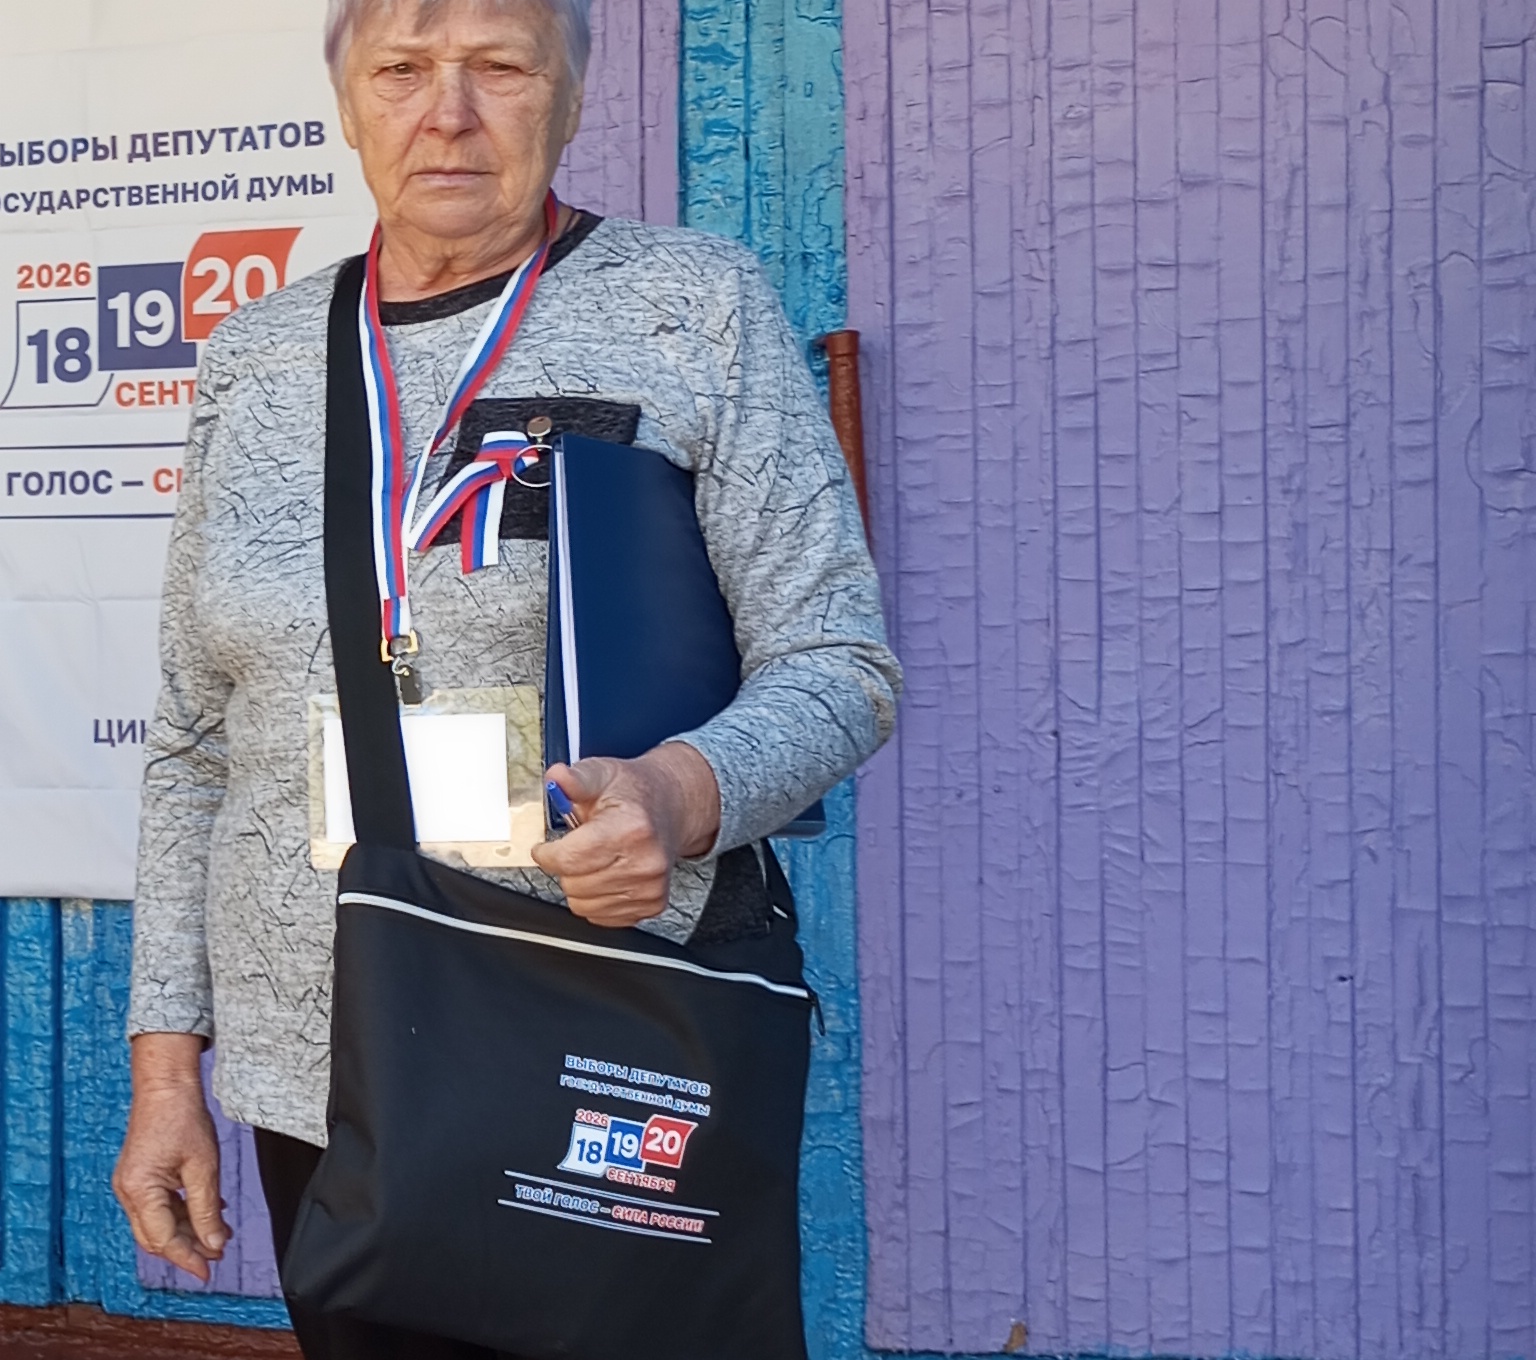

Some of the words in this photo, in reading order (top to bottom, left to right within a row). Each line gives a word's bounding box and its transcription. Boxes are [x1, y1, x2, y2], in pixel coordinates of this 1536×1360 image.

[127, 120, 326, 163] ДЕПУТАТОВ
[247, 172, 334, 202] ДУМЫ
[16, 262, 92, 290] 2026
[26, 327, 92, 385] 18
[107, 289, 175, 348] 19
[192, 254, 278, 315] 20
[115, 379, 198, 407] СЕНТ
[6, 468, 113, 496] ГОЛОС
[565, 1054, 628, 1079] ВЫБОРЫ
[628, 1067, 711, 1097] ДЕПУТАТОВ
[560, 1073, 673, 1108] ГОСУДАРСТВЕННОЙ
[673, 1099, 710, 1117] ДУМЫ
[575, 1108, 609, 1127] 2026
[576, 1138, 602, 1165] 18
[612, 1131, 638, 1159] 19
[645, 1127, 681, 1155] 20
[606, 1167, 676, 1193] СЕНТЯБРЯ
[515, 1184, 553, 1203] ТВОЙ
[554, 1192, 600, 1213] ГОЛОС
